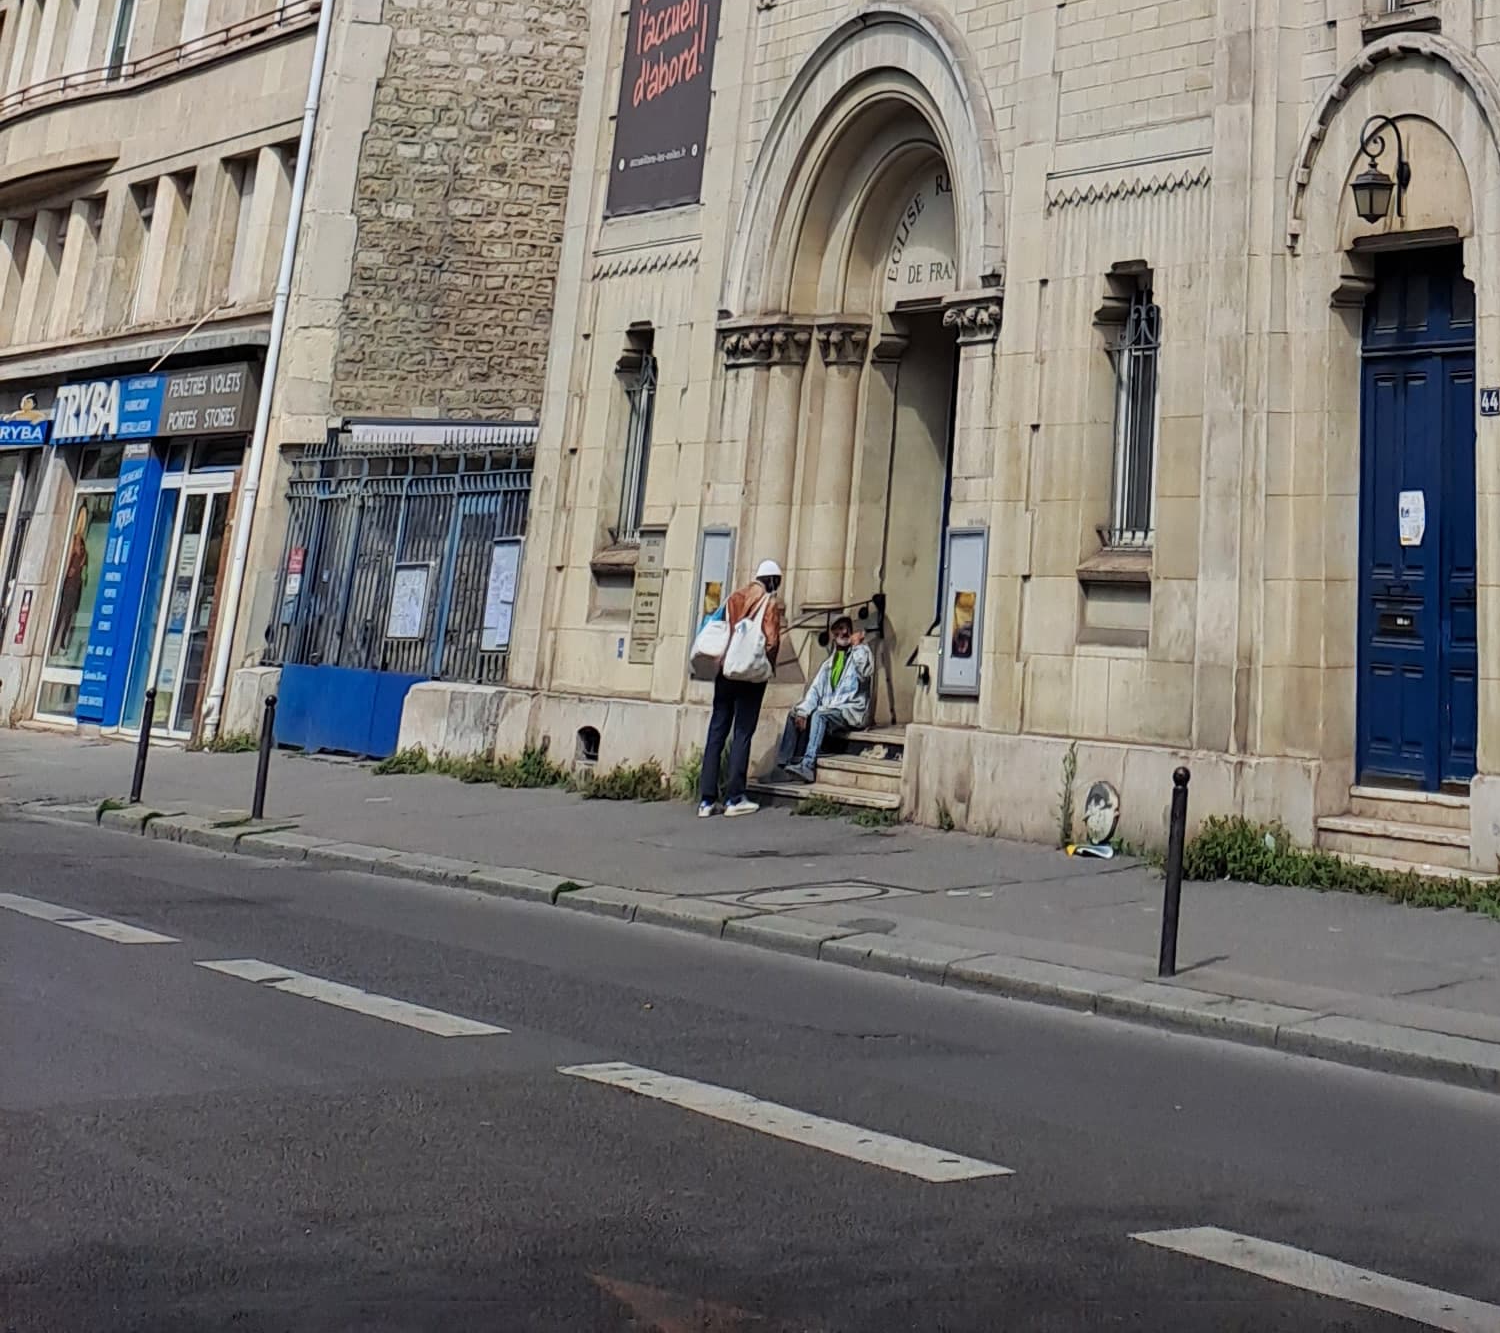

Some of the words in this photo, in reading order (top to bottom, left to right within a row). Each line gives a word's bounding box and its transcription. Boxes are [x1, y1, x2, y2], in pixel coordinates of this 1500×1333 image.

[907, 264, 923, 285] DE
[210, 372, 241, 394] VOLETS
[53, 379, 120, 439] TRYBA
[1481, 391, 1499, 411] 44
[167, 409, 198, 431] PORTES
[204, 406, 236, 429] STORES
[0, 425, 43, 441] RYBA
